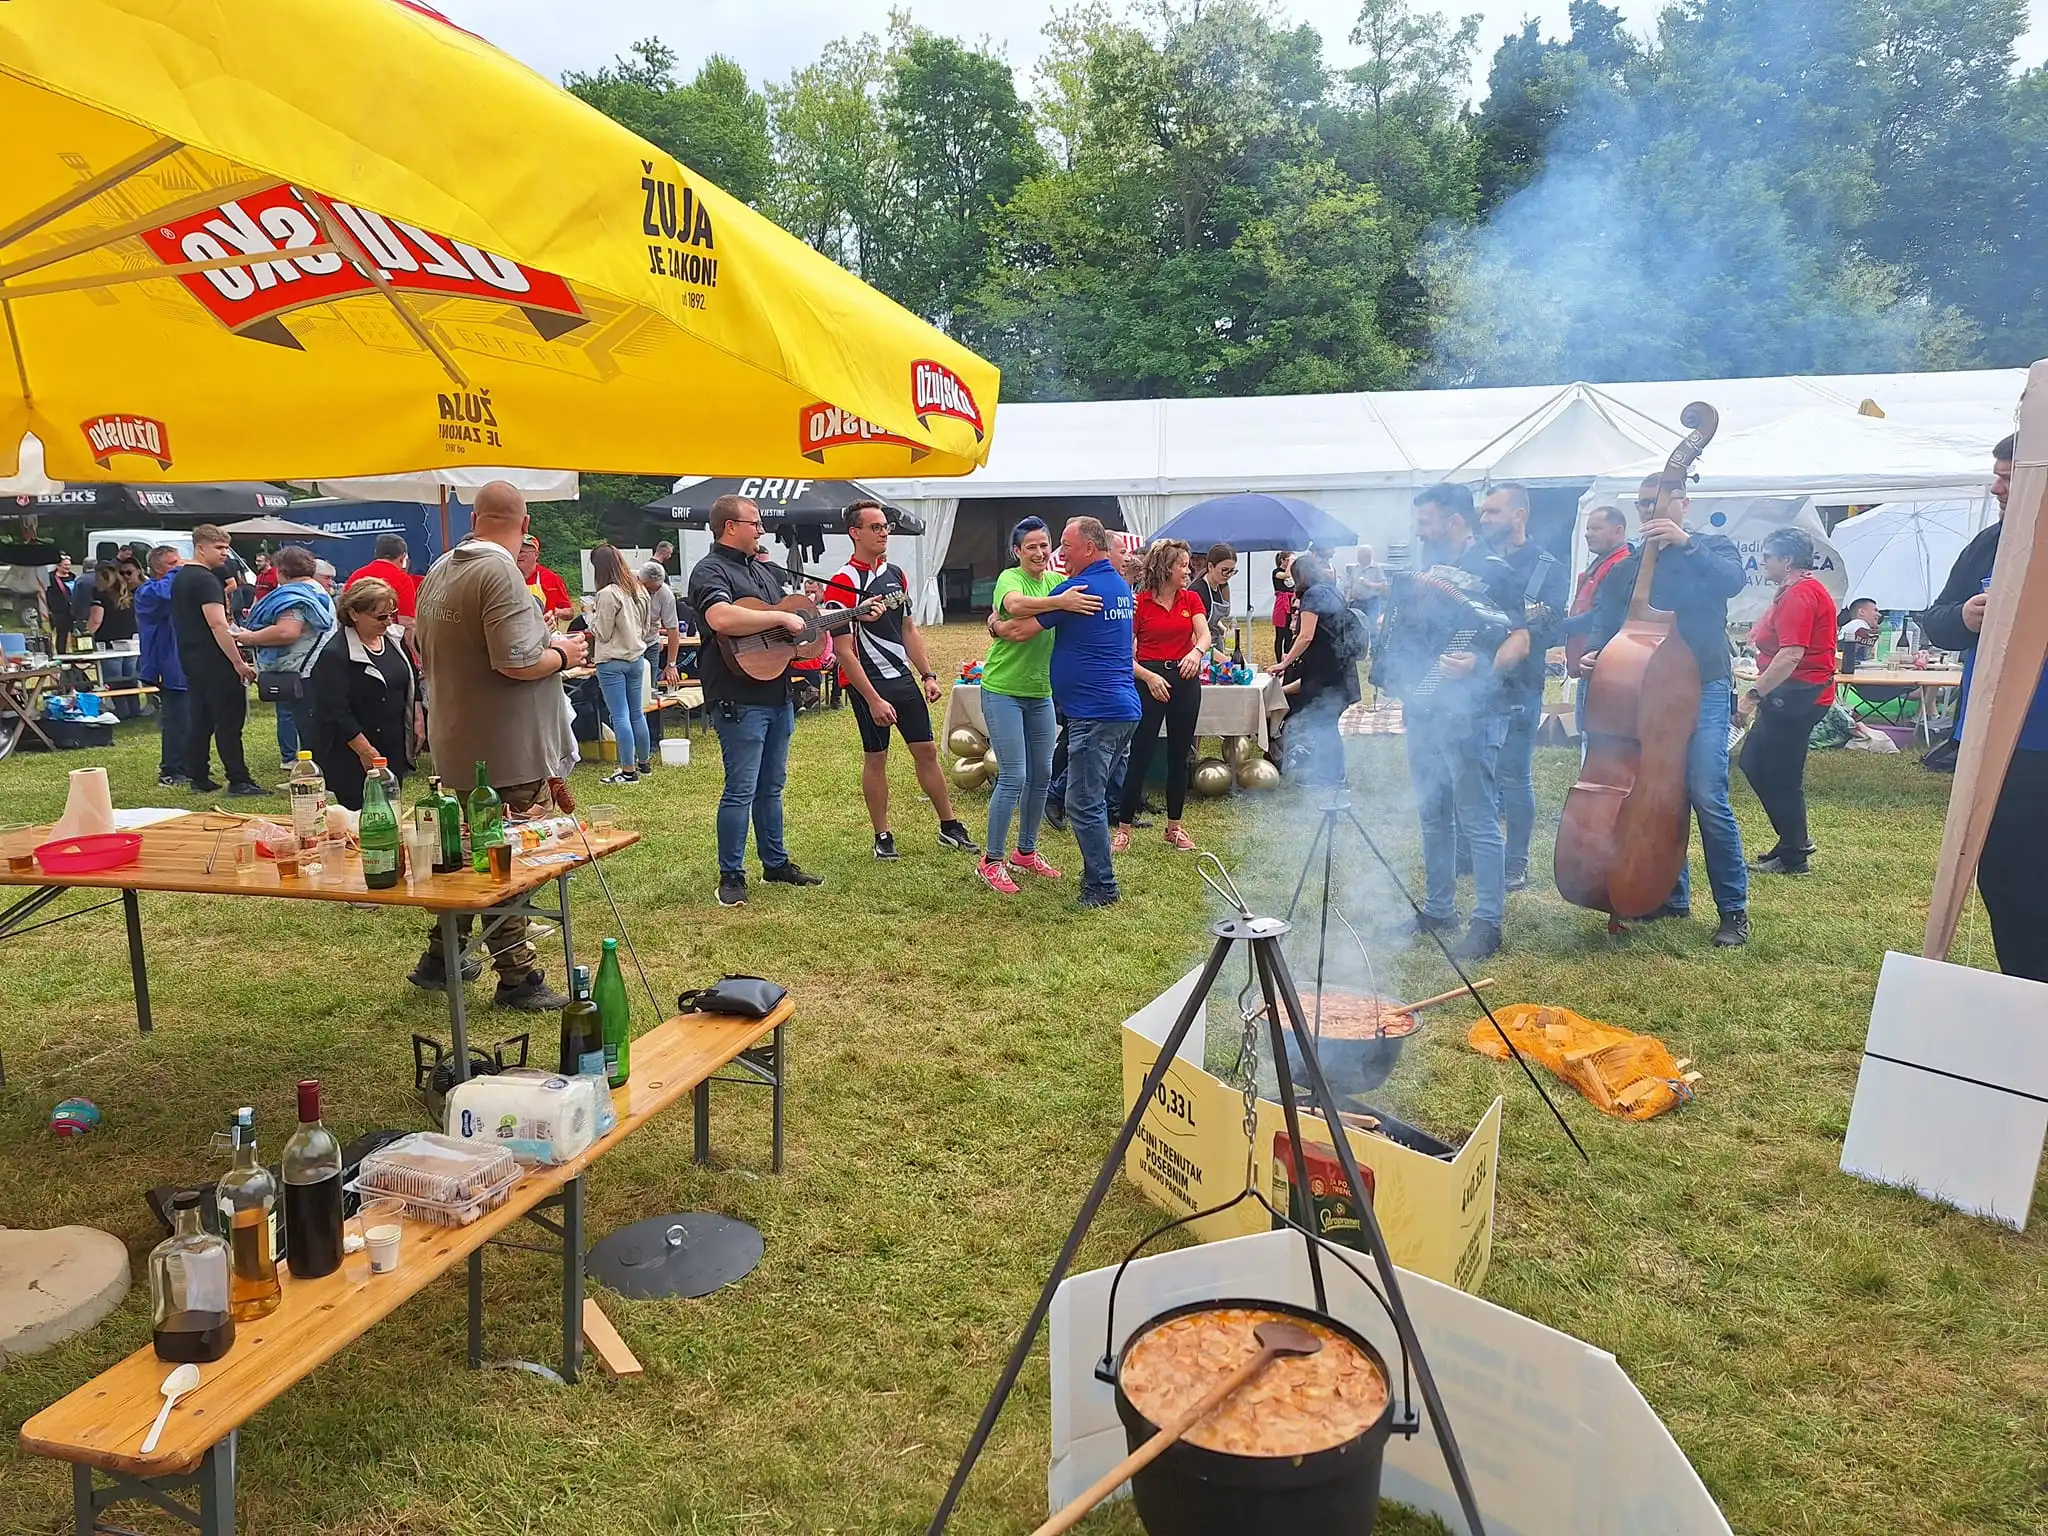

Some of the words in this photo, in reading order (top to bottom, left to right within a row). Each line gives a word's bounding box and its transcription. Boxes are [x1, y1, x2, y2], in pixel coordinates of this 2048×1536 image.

[640, 159, 714, 250] ŽUJA
[648, 245, 667, 276] JE
[668, 247, 718, 288] ZAKON!
[916, 364, 977, 420] Ožujsko
[322, 518, 395, 533] DELTAMETAL
[1116, 596, 1131, 608] DVD
[1145, 1147, 1190, 1192] POSEBNIM
[1158, 1139, 1203, 1185] TRENUTAK
[1139, 1158, 1147, 1173] UZ
[1148, 1165, 1164, 1186] NOVO
[1164, 1177, 1199, 1213] PAKIRANJE
